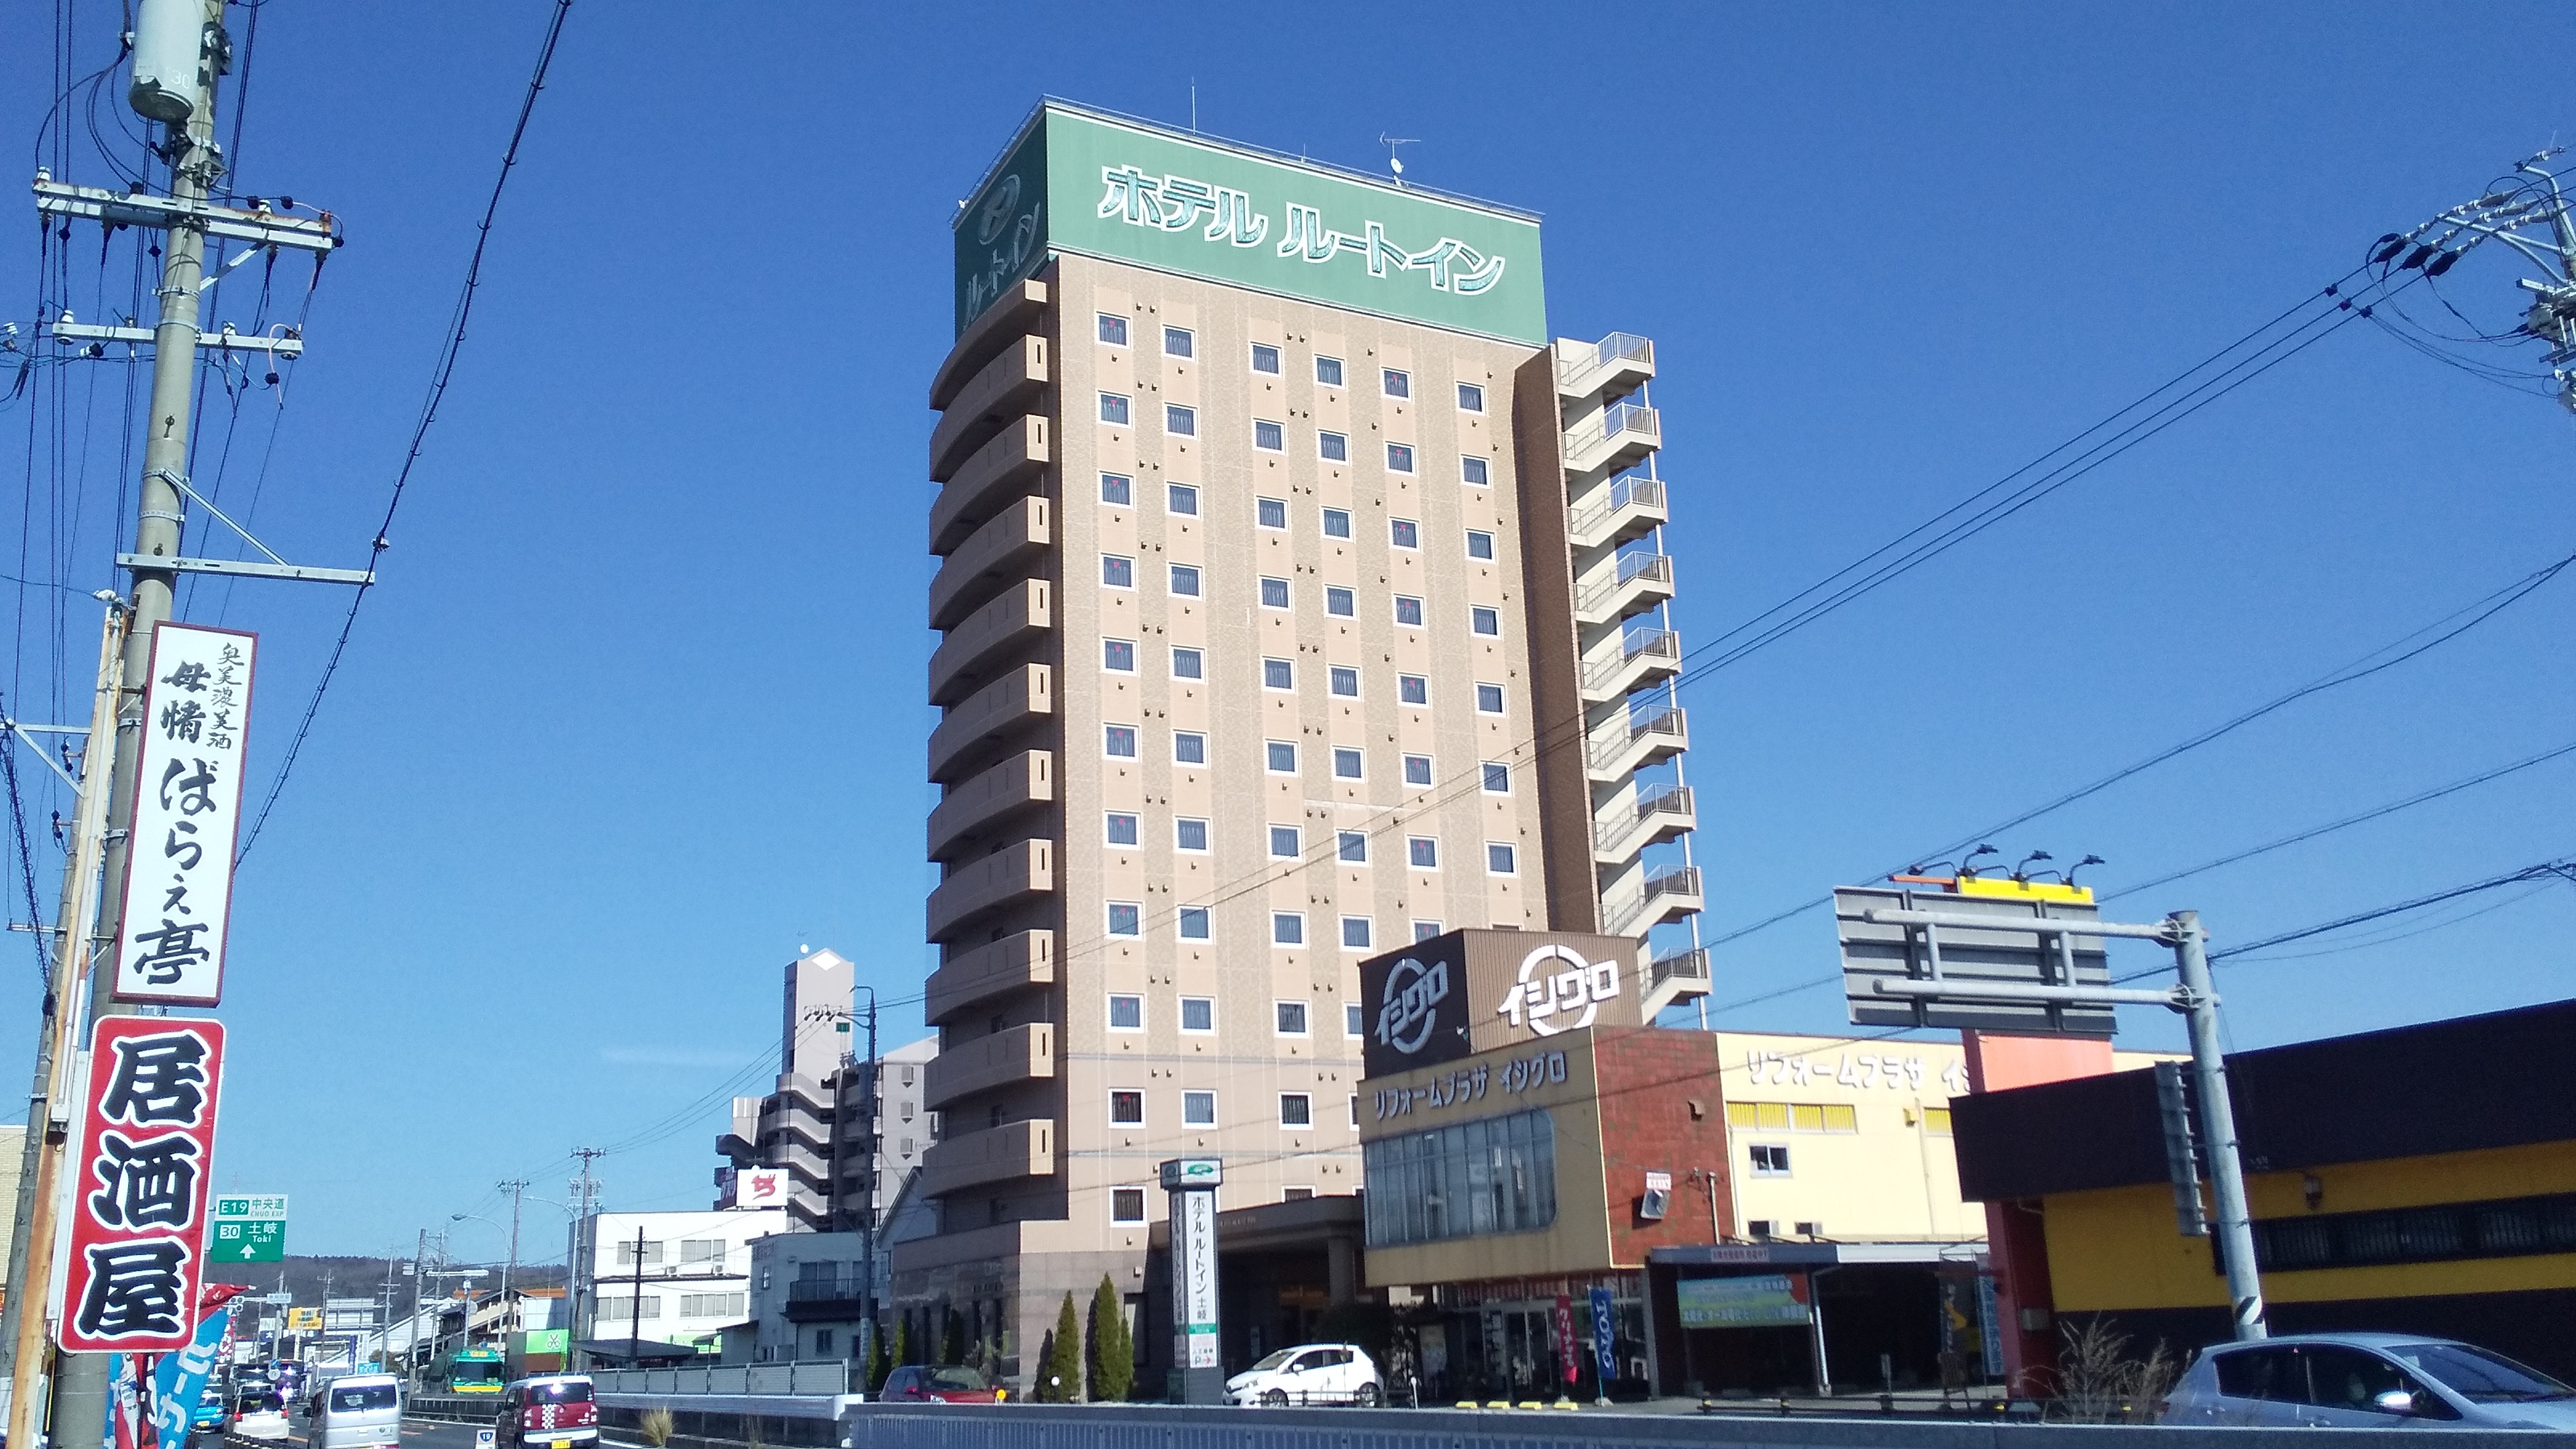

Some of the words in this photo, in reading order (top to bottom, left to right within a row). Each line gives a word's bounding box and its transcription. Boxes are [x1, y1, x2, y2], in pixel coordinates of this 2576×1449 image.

[1098, 164, 1268, 248] ホテル
[1277, 201, 1505, 295] ルートイン
[1374, 960, 1449, 1045] イシグロ
[1497, 959, 1620, 1026] イシグロ
[1375, 1064, 1488, 1121] リフォームプラザ
[1499, 1051, 1568, 1093] イシグロ
[1748, 1050, 1923, 1091] リフォームプラザ
[74, 1030, 211, 1340] 居酒屋
[252, 1197, 284, 1210] 中央道
[221, 1201, 248, 1214] E19
[248, 1222, 278, 1234] 土岐
[221, 1227, 239, 1237] 30
[482, 1433, 490, 1441] 19
